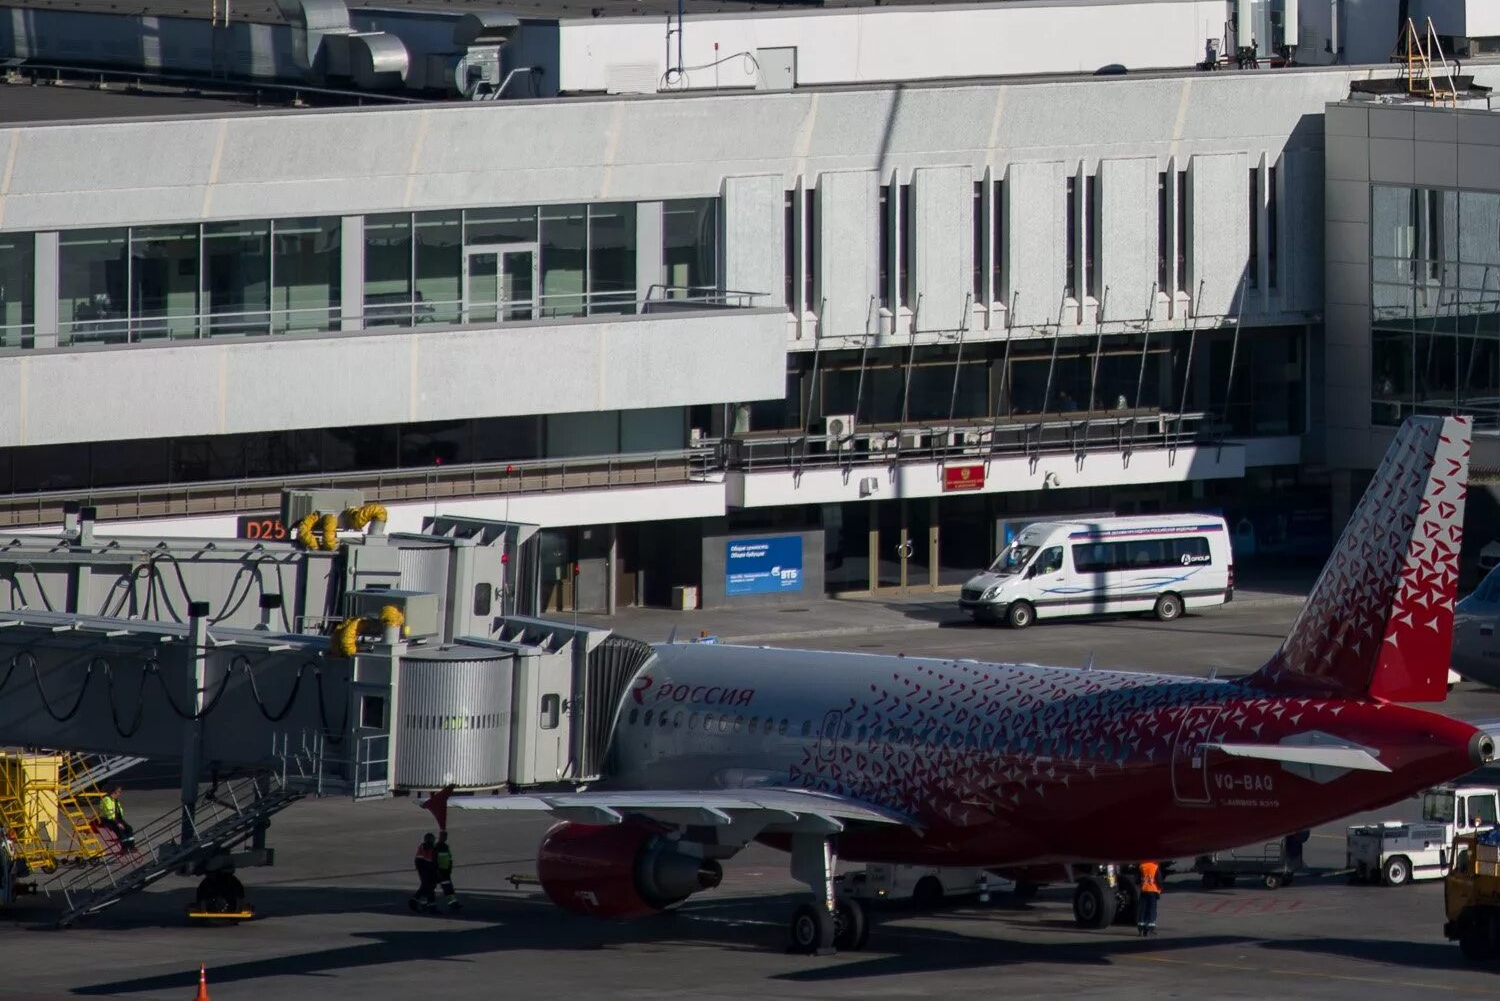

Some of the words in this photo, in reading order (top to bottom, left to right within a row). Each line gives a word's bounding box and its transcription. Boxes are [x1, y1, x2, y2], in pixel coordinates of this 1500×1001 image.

[246, 520, 286, 539] D25
[655, 683, 755, 707] РОССИЯ
[1215, 774, 1273, 791] VQ-BAQ
